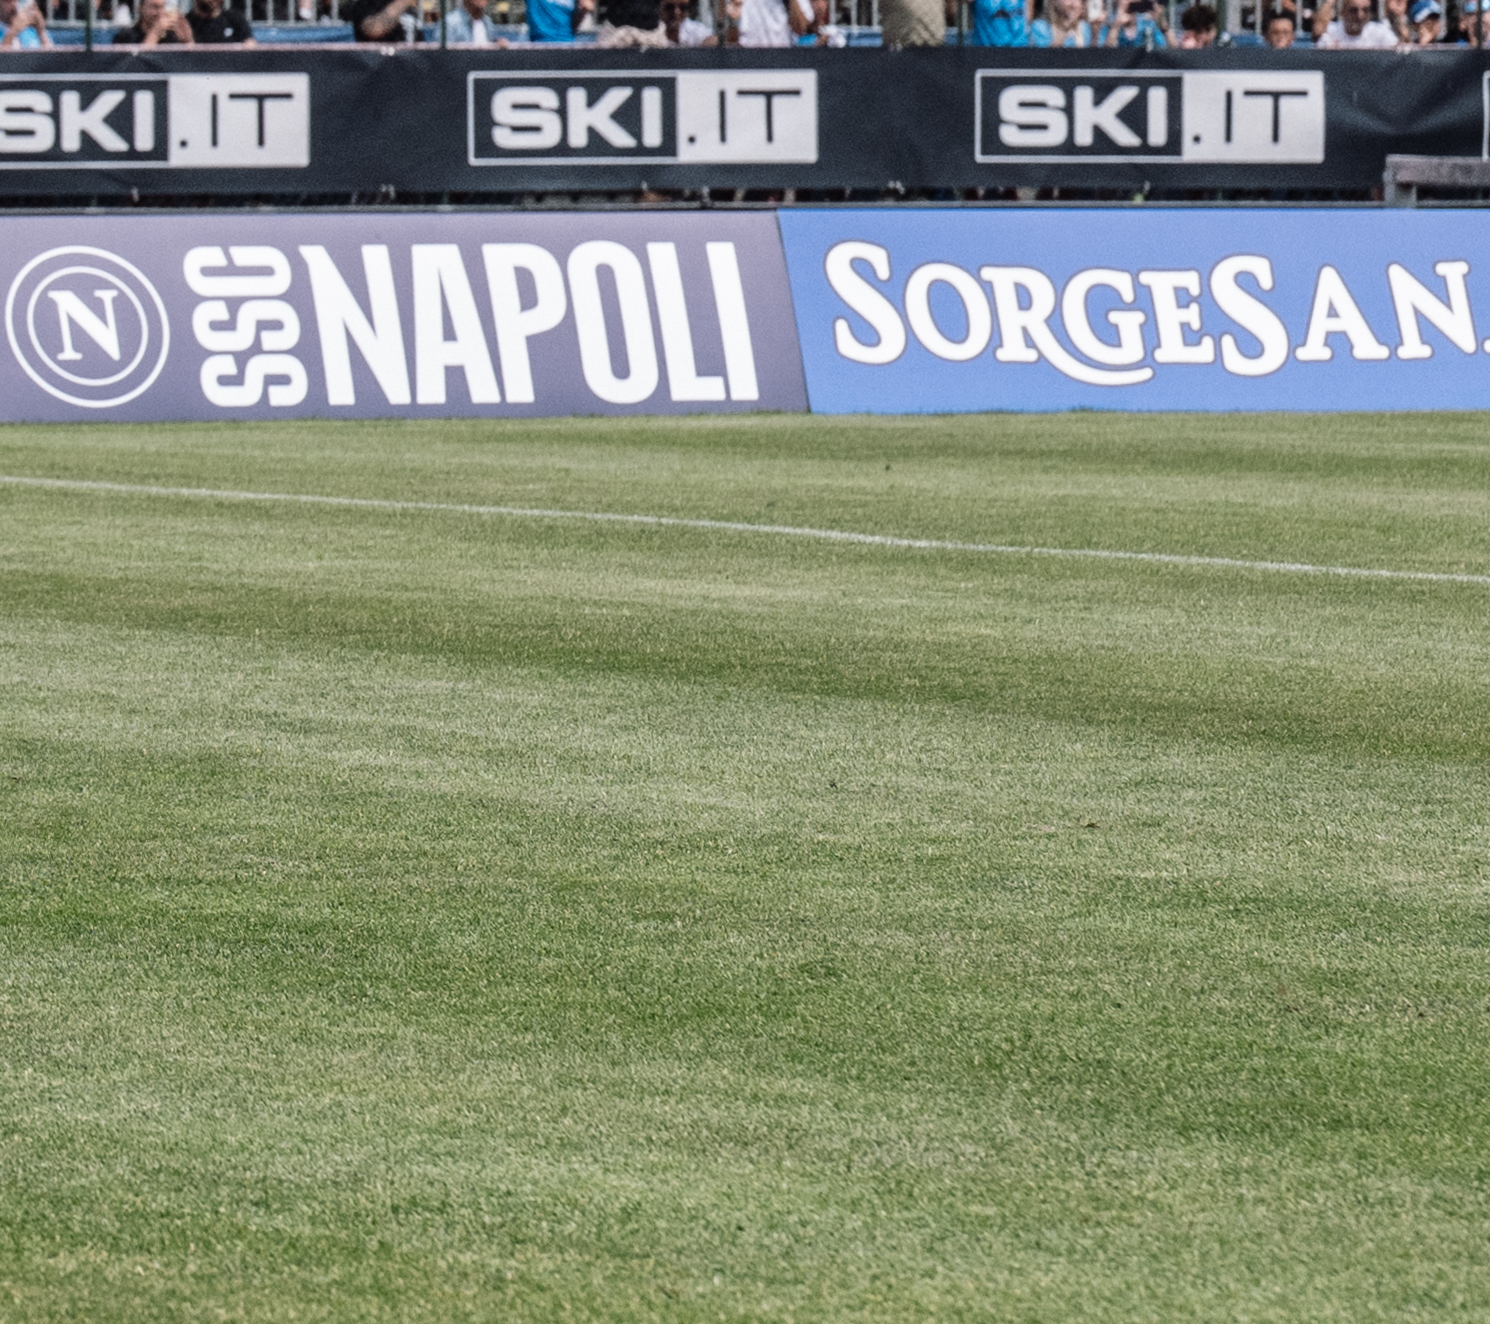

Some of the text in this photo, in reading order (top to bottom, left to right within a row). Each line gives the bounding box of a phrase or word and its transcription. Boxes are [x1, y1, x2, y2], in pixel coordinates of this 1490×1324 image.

[492, 86, 802, 149] SKI.IT
[999, 84, 1309, 147] SKI.IT
[183, 245, 310, 408] SSC
[299, 240, 760, 406] NAPOLI
